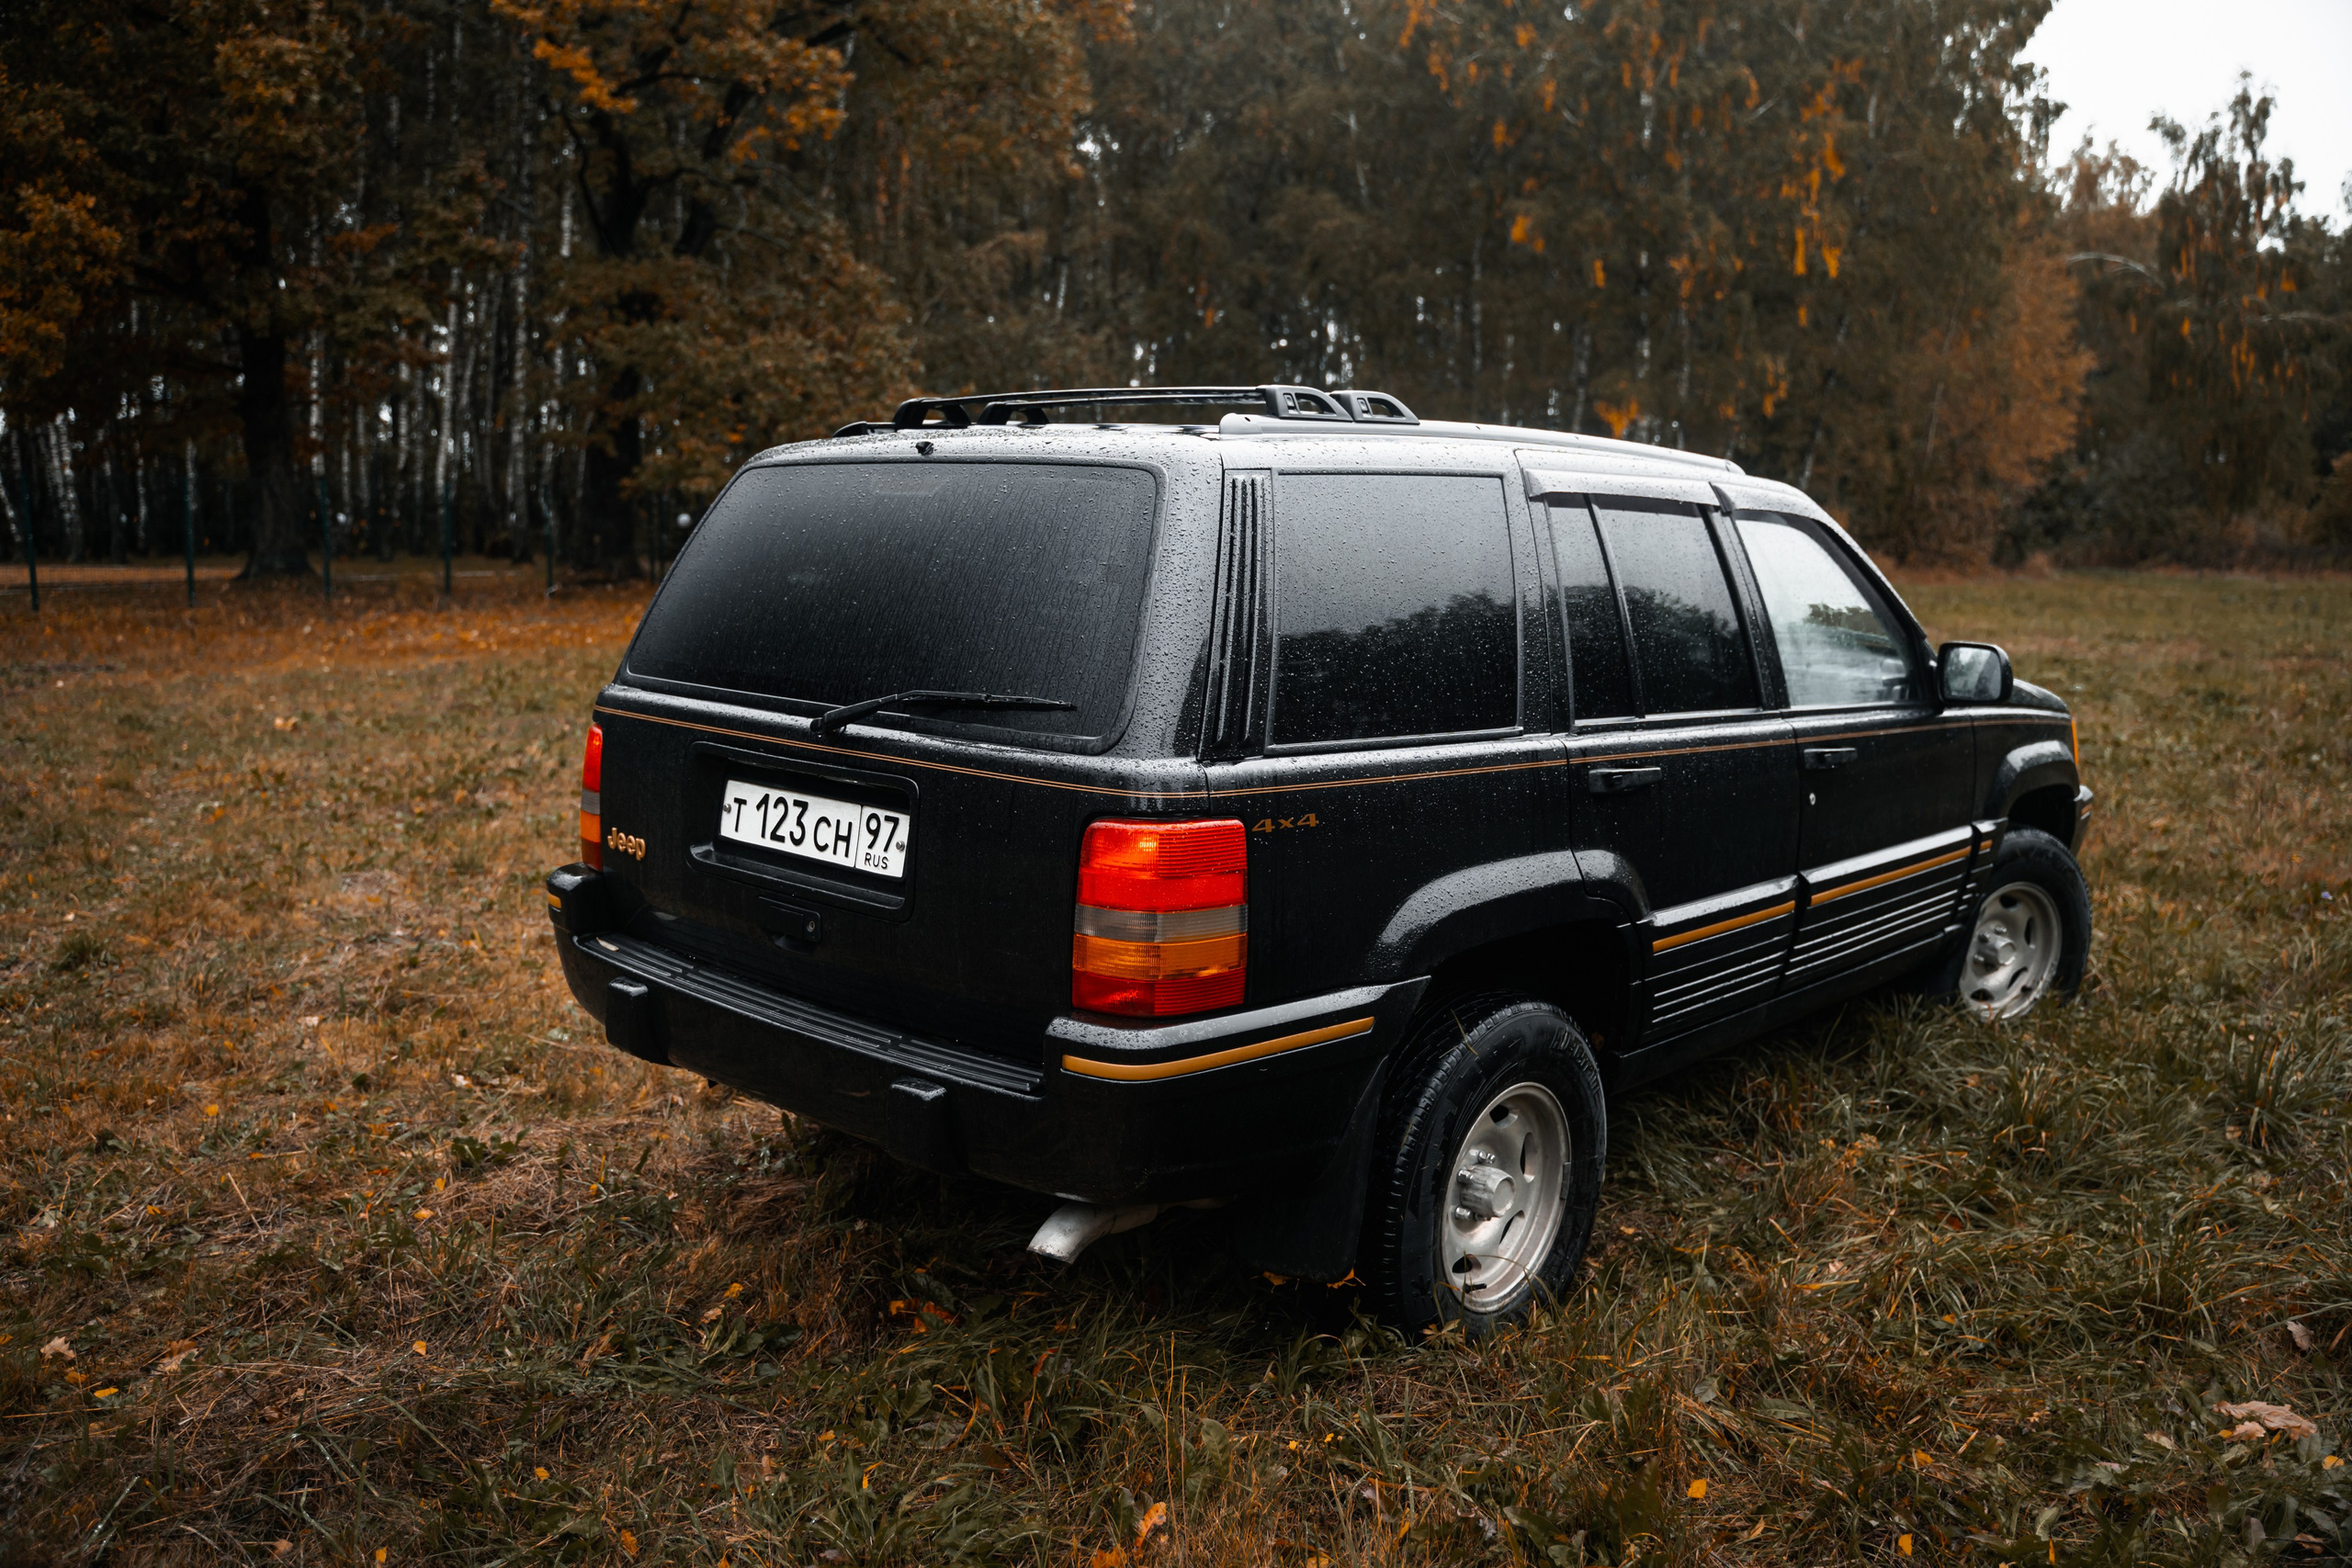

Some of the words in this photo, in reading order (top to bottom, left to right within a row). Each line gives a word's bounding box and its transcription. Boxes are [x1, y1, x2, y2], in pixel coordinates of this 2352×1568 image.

[755, 793, 808, 846] 123
[865, 812, 899, 852] 97
[1251, 813, 1319, 833] 4x4
[607, 827, 646, 861] Jeep
[864, 852, 889, 870] RUS
